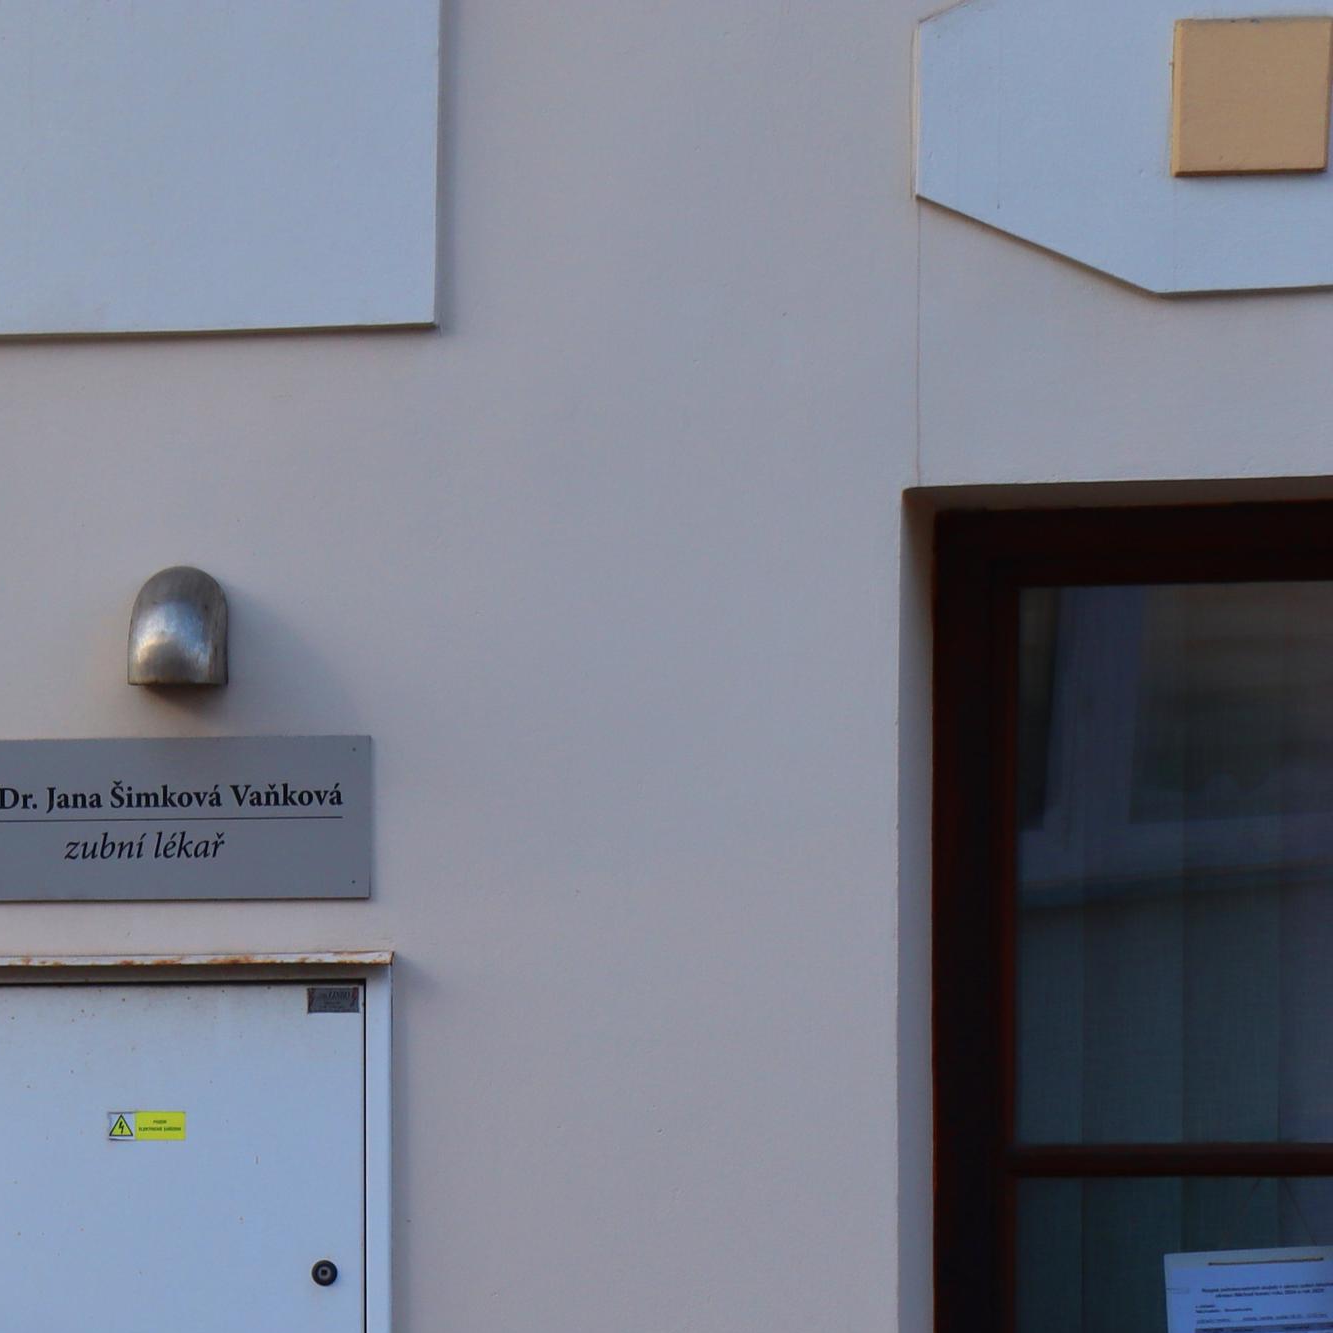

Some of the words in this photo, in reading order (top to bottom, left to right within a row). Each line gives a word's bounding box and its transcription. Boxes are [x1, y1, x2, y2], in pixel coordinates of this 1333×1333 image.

[45, 786, 103, 814] Jana
[109, 780, 222, 809] Šimková
[229, 781, 343, 808] Vaňková
[63, 831, 146, 861] zubní
[153, 830, 226, 859] lékař
